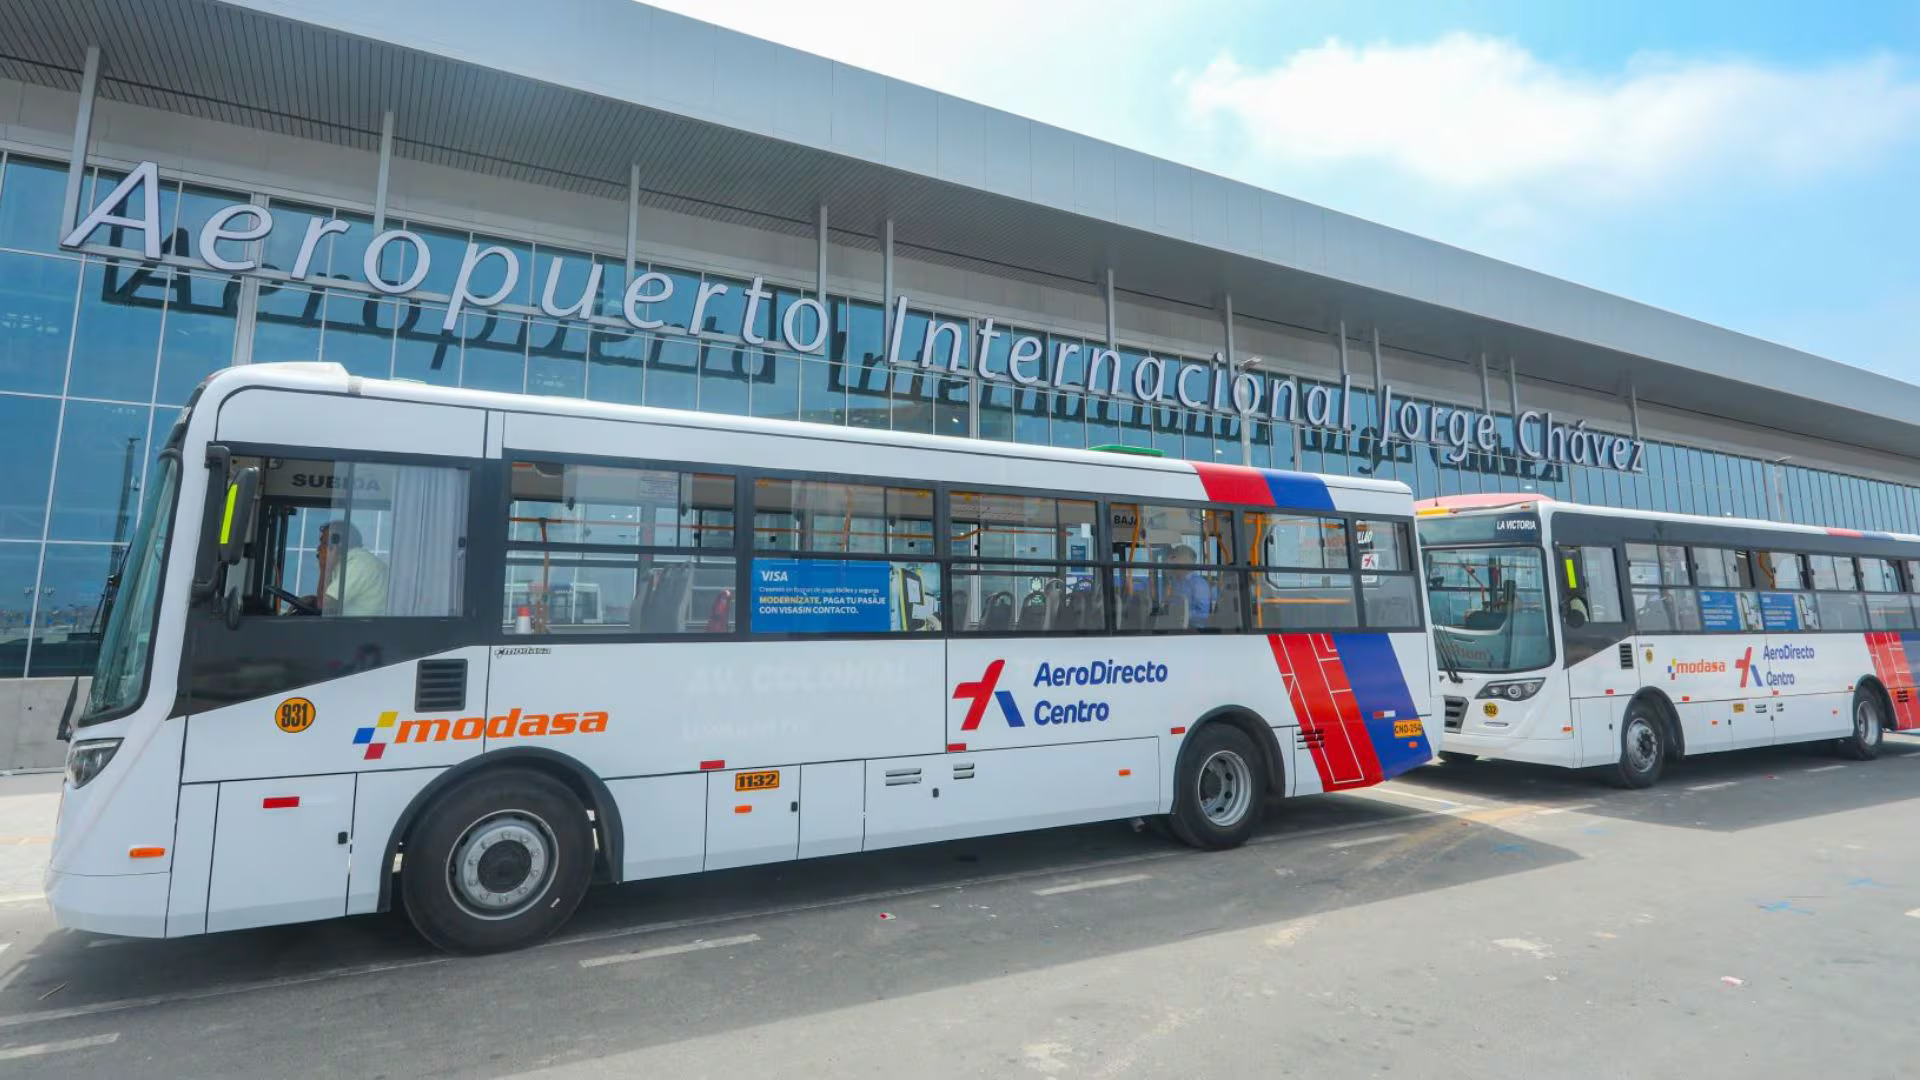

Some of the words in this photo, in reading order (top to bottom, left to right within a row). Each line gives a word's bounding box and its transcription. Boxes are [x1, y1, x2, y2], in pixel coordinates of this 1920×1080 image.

[60, 161, 829, 352] Aeropuerto
[889, 295, 1351, 430] Internacional
[1379, 385, 1496, 462] Jorge
[1518, 410, 1645, 473] Chávez
[291, 472, 382, 492] SUBIDA
[1496, 520, 1505, 530] LA
[1506, 519, 1537, 530] VICTORIA
[762, 570, 788, 581] VISA
[823, 596, 846, 605] PAGA
[846, 596, 857, 605] TU
[759, 606, 778, 615] CON
[1763, 644, 1815, 661] AeroDirecto
[1033, 658, 1169, 688] AeroDirecto
[1676, 659, 1726, 674] modasa
[1766, 671, 1796, 687] Centro
[281, 703, 308, 728] 931
[1034, 698, 1110, 726] Centro
[394, 708, 610, 744] modasa
[738, 772, 778, 790] 1132
